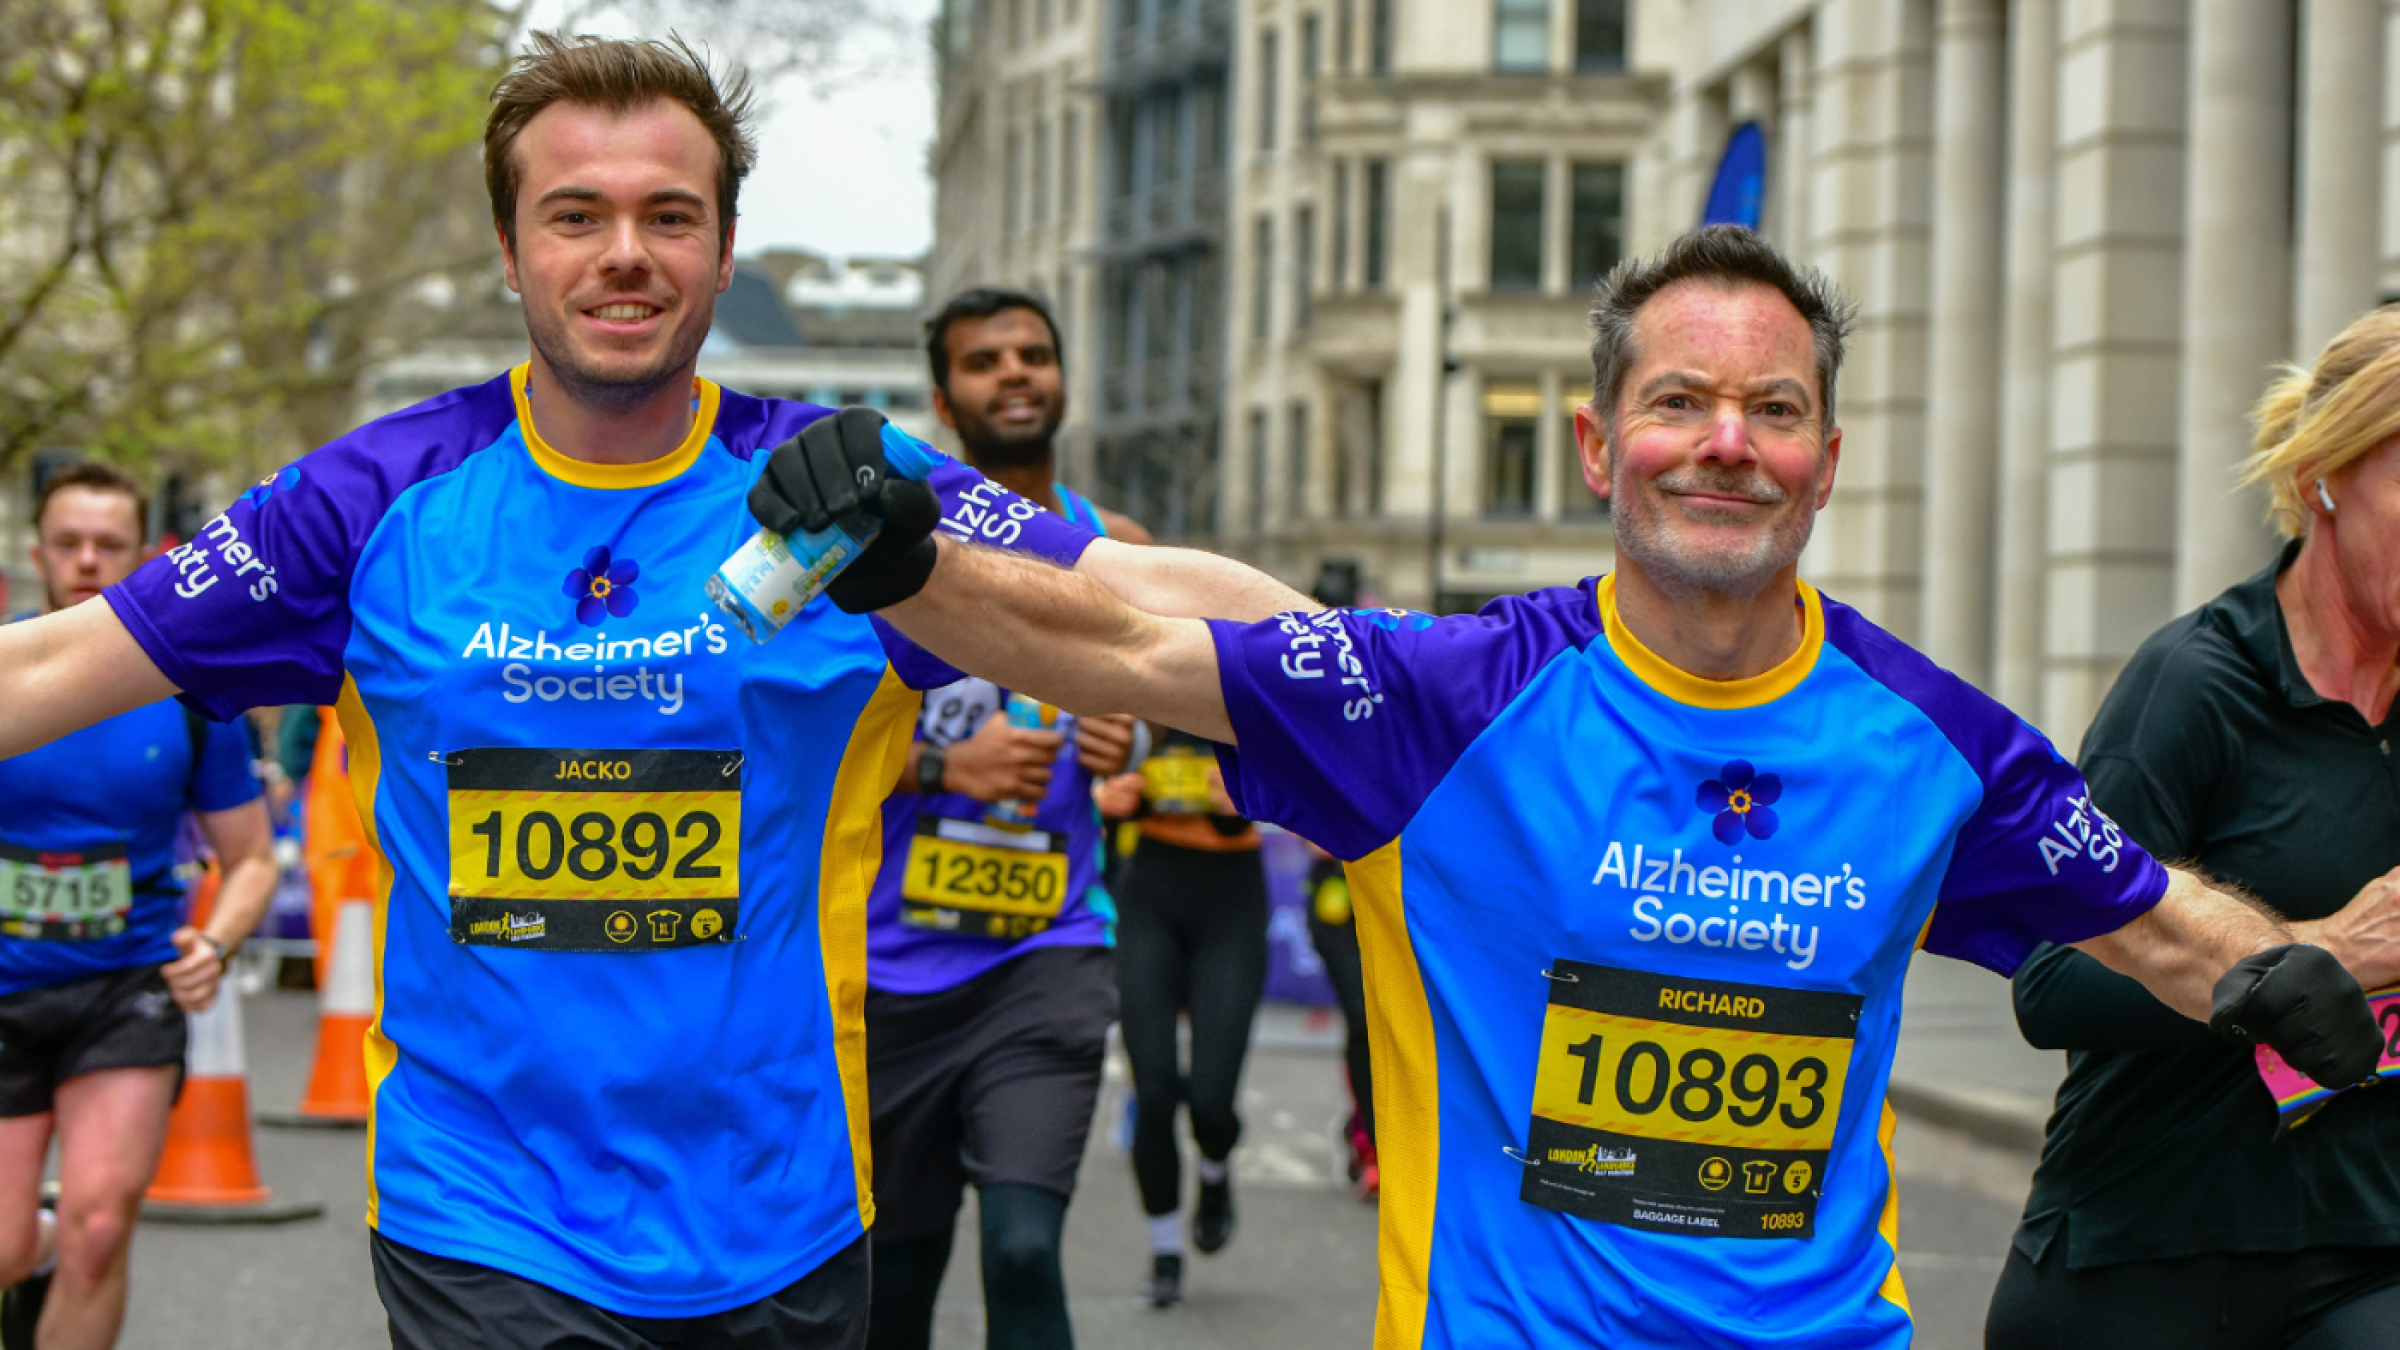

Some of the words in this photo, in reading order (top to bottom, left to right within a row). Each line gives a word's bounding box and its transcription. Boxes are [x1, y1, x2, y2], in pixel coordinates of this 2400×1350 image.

[462, 612, 727, 661] Alzheimer's
[502, 662, 684, 715] Society
[554, 760, 632, 780] JACKO
[472, 810, 722, 881] 10892
[13, 874, 112, 909] 5715
[921, 851, 1058, 904] 12350
[1592, 841, 1866, 910] Alzheimer's
[702, 924, 711, 935] 5
[1629, 895, 1819, 970] Society
[1658, 987, 1765, 1019] RICHARD
[1566, 1033, 1829, 1130] 10893
[1792, 1176, 1801, 1188] 5
[1632, 1208, 1686, 1225] BAGGAGE
[1687, 1215, 1720, 1228] LABEL
[1760, 1211, 1804, 1230] 10893
